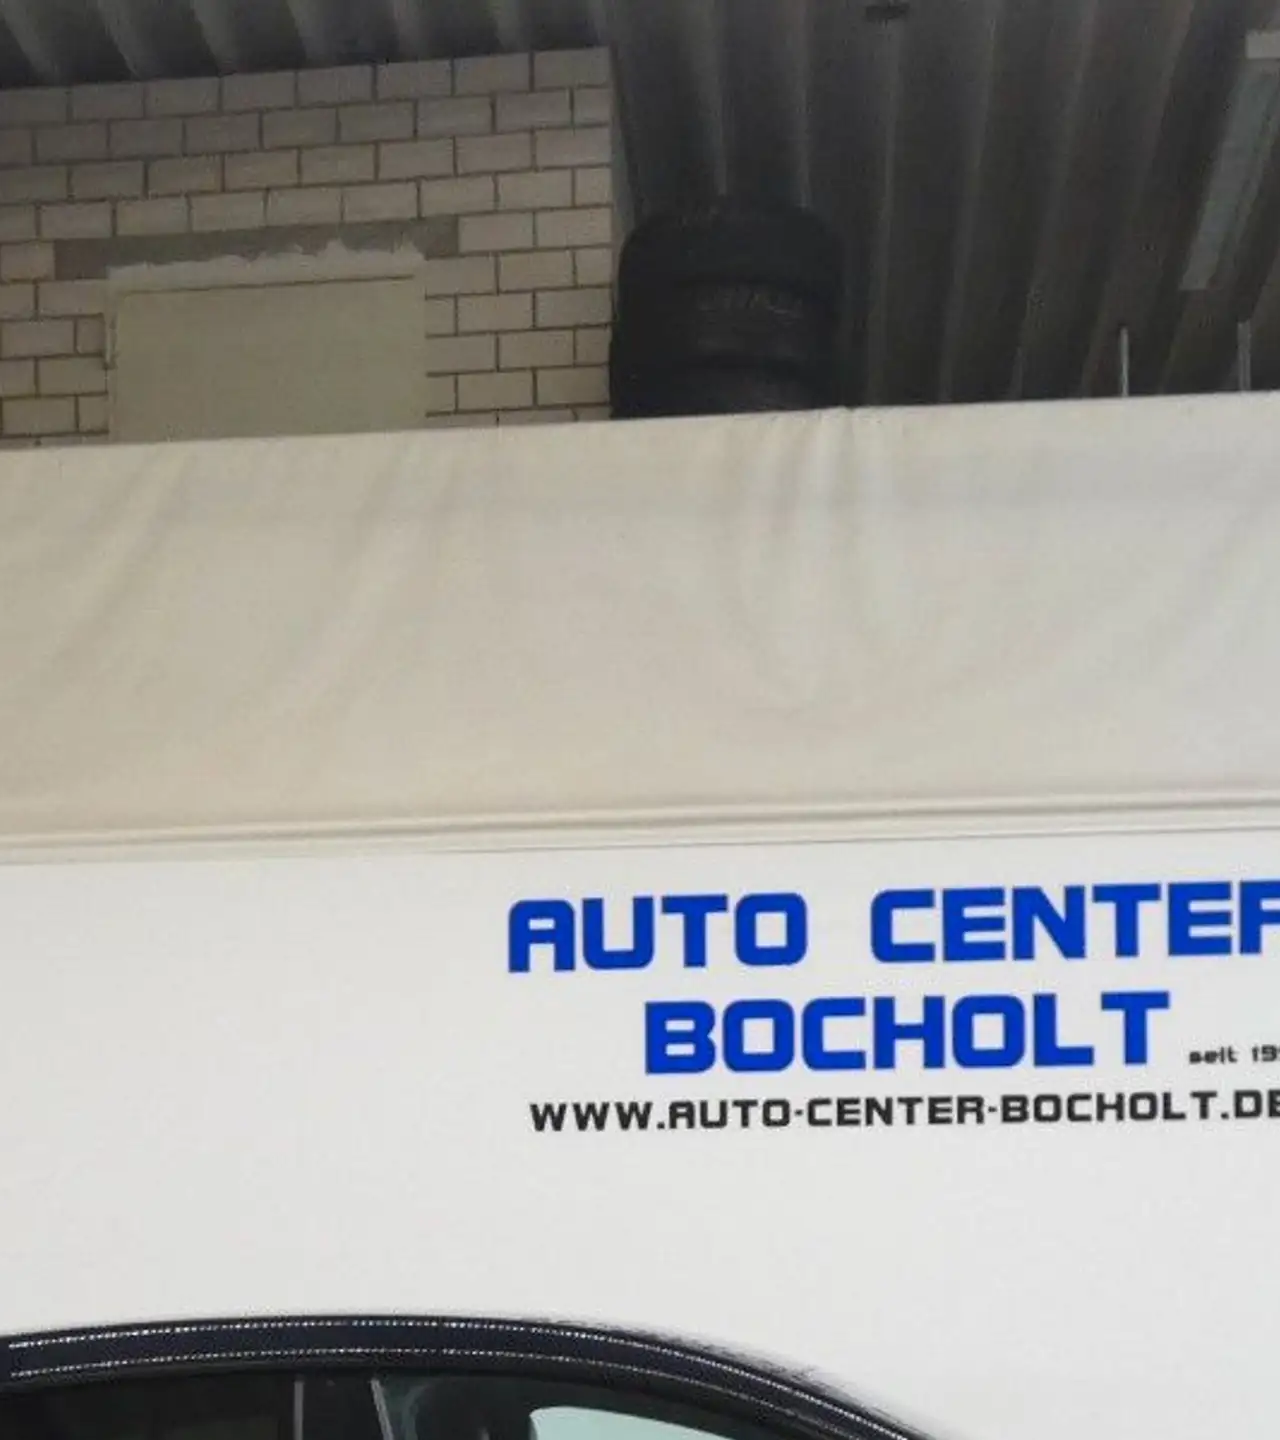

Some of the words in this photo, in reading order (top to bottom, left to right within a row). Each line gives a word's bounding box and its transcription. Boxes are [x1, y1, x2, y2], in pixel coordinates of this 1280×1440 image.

[507, 891, 809, 974] AUTO
[644, 990, 1171, 1076] BOCHOLT
[1188, 1046, 1238, 1064] seit
